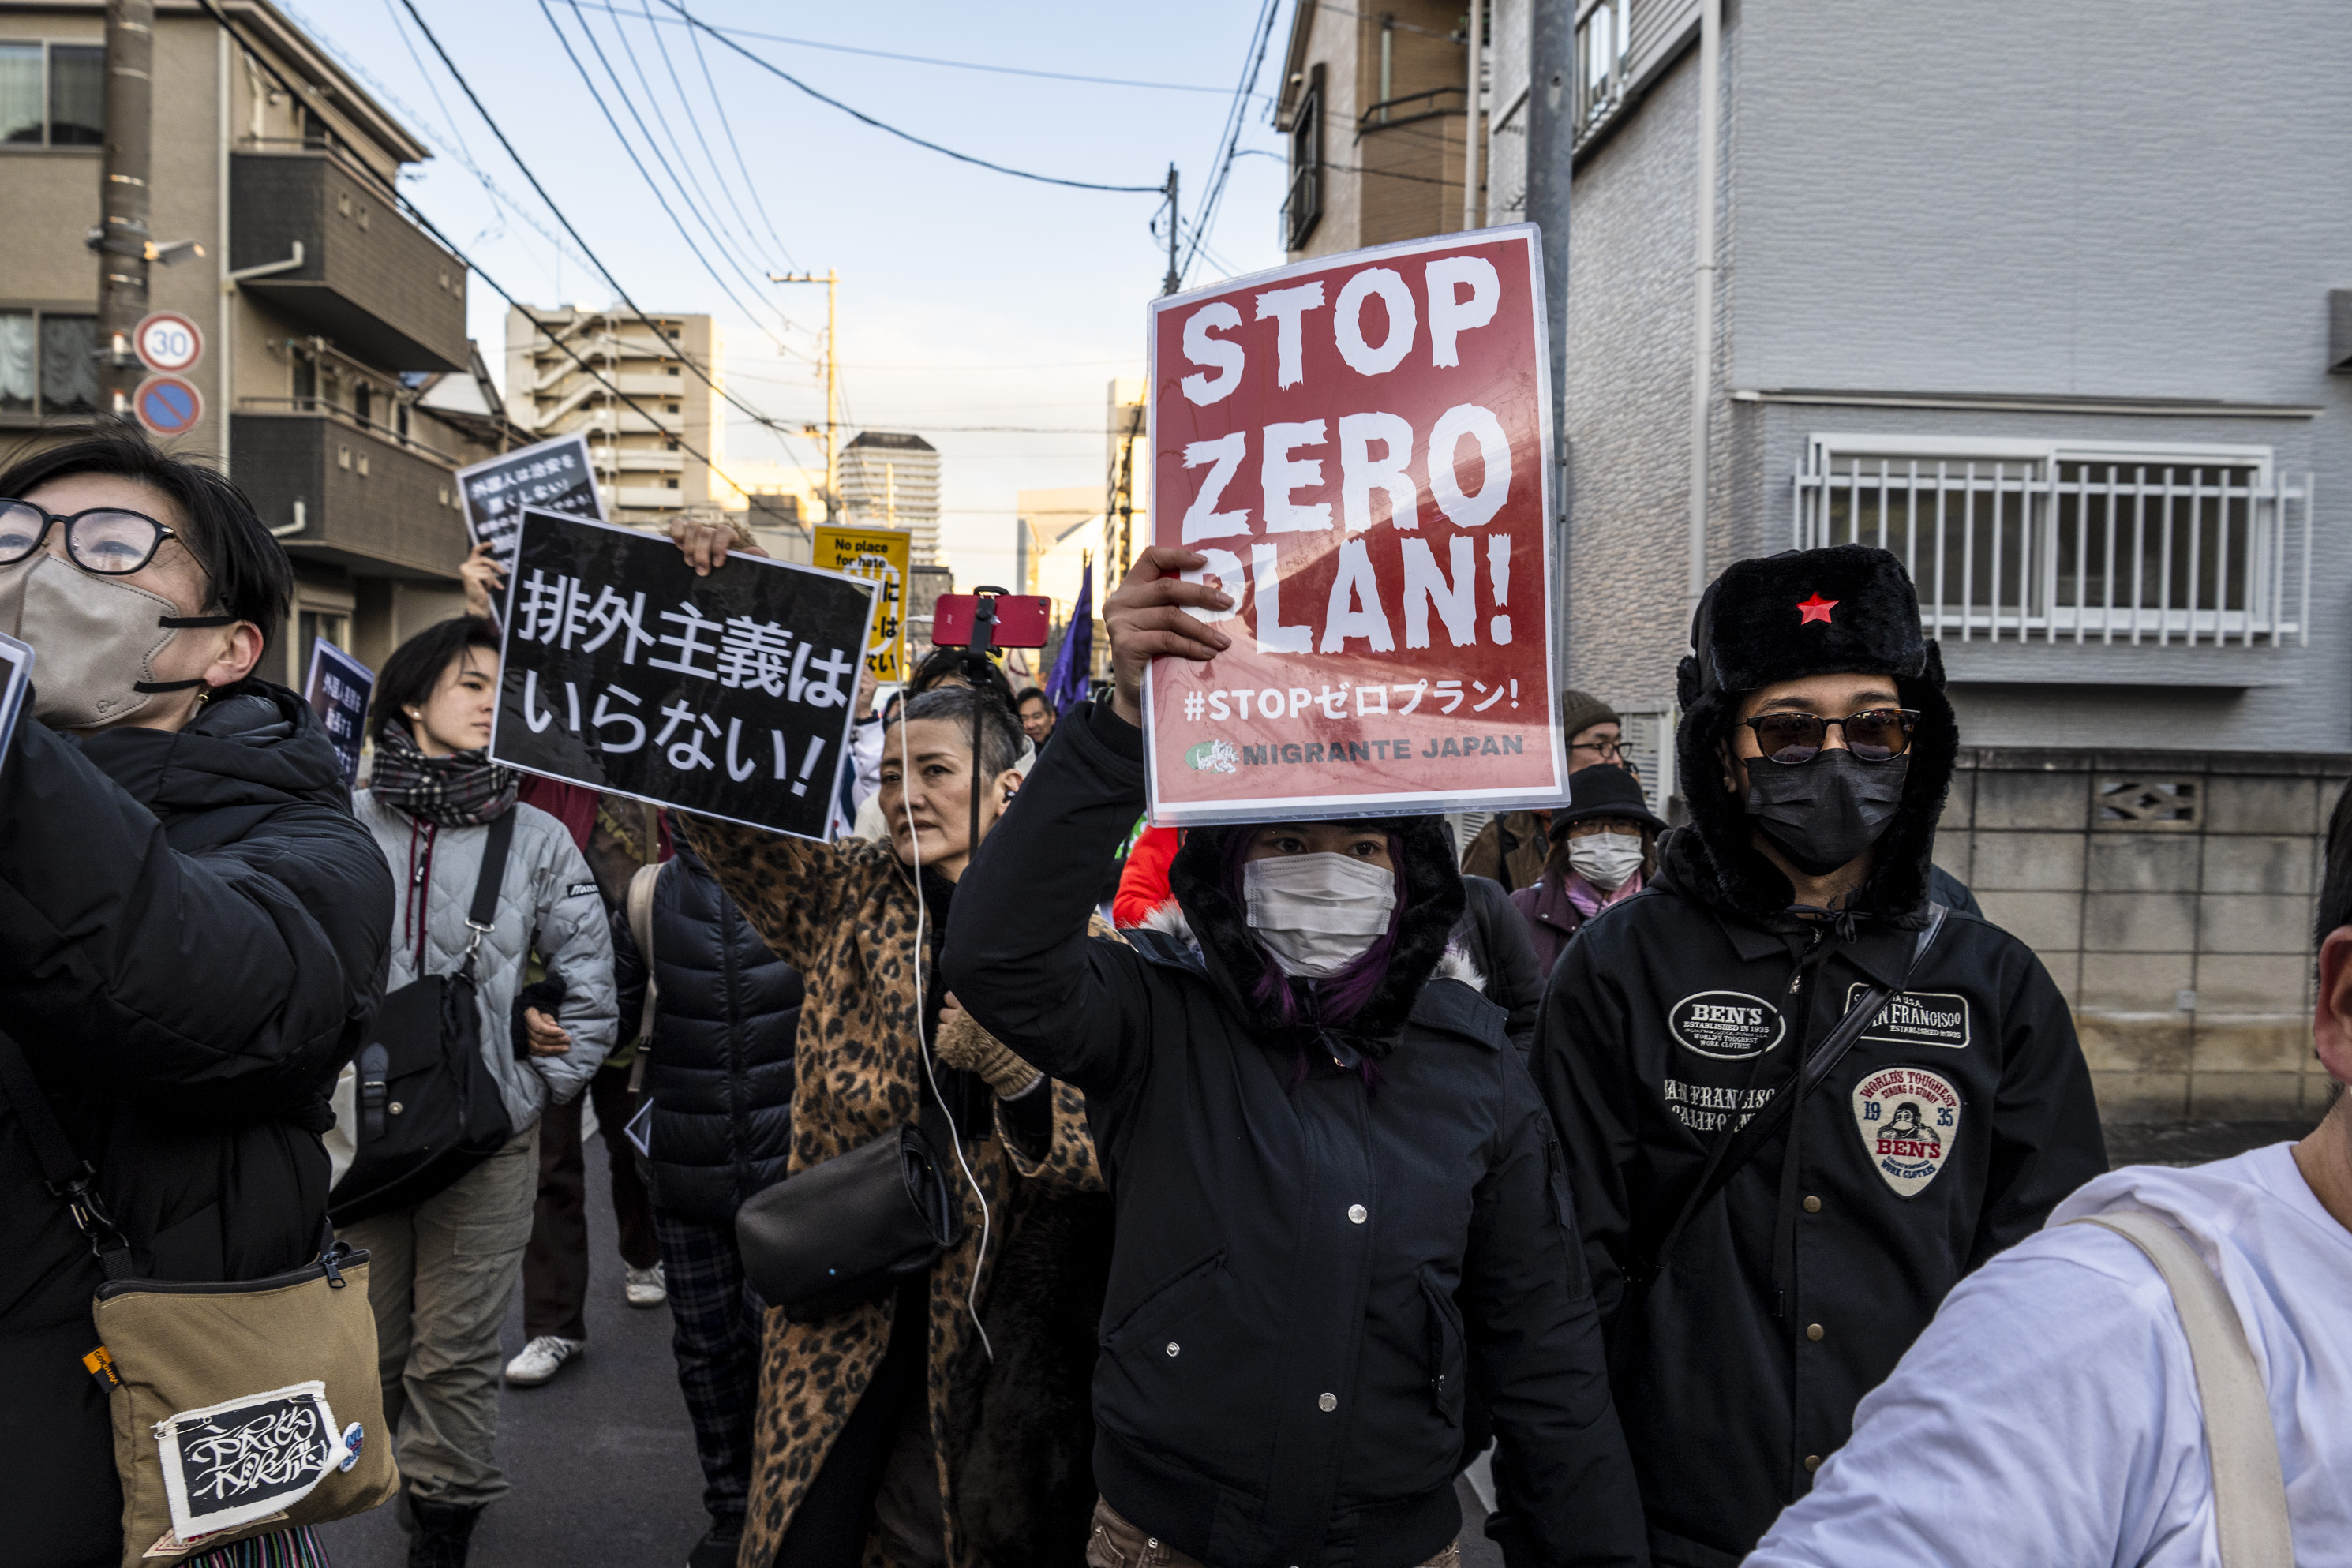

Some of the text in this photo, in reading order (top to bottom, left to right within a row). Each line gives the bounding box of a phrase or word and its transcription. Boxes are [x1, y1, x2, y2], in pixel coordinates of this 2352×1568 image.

[152, 330, 187, 357] 30
[1181, 256, 1500, 407] STOP
[1182, 402, 1513, 546] ZERO
[835, 538, 888, 553] No place
[836, 554, 886, 568] for hate
[1180, 533, 1512, 654] PLAN!
[518, 568, 852, 708] 排外主義は
[872, 616, 898, 638] は
[1184, 678, 1519, 721] #STOPゼロプラン!
[524, 669, 826, 798] いらない!
[1243, 735, 1523, 766] MIGRANTE JAPAN
[1683, 1020, 1740, 1031] ESTABLISHED
[1691, 1004, 1762, 1025] BEN'S
[1890, 1003, 1961, 1027] FRANCISCO
[1724, 1035, 1758, 1044] TOUGHEST
[1889, 1025, 1939, 1036] ESTABLISHED
[1860, 1070, 1957, 1107] WORLD'S TOUGHEST
[1881, 1084, 1908, 1099] STRONG
[1915, 1087, 1940, 1104] STURDY
[1863, 1101, 1953, 1127] 19 35
[1876, 1139, 1941, 1158] BEN'S
[94, 1351, 118, 1385] CORDURA
